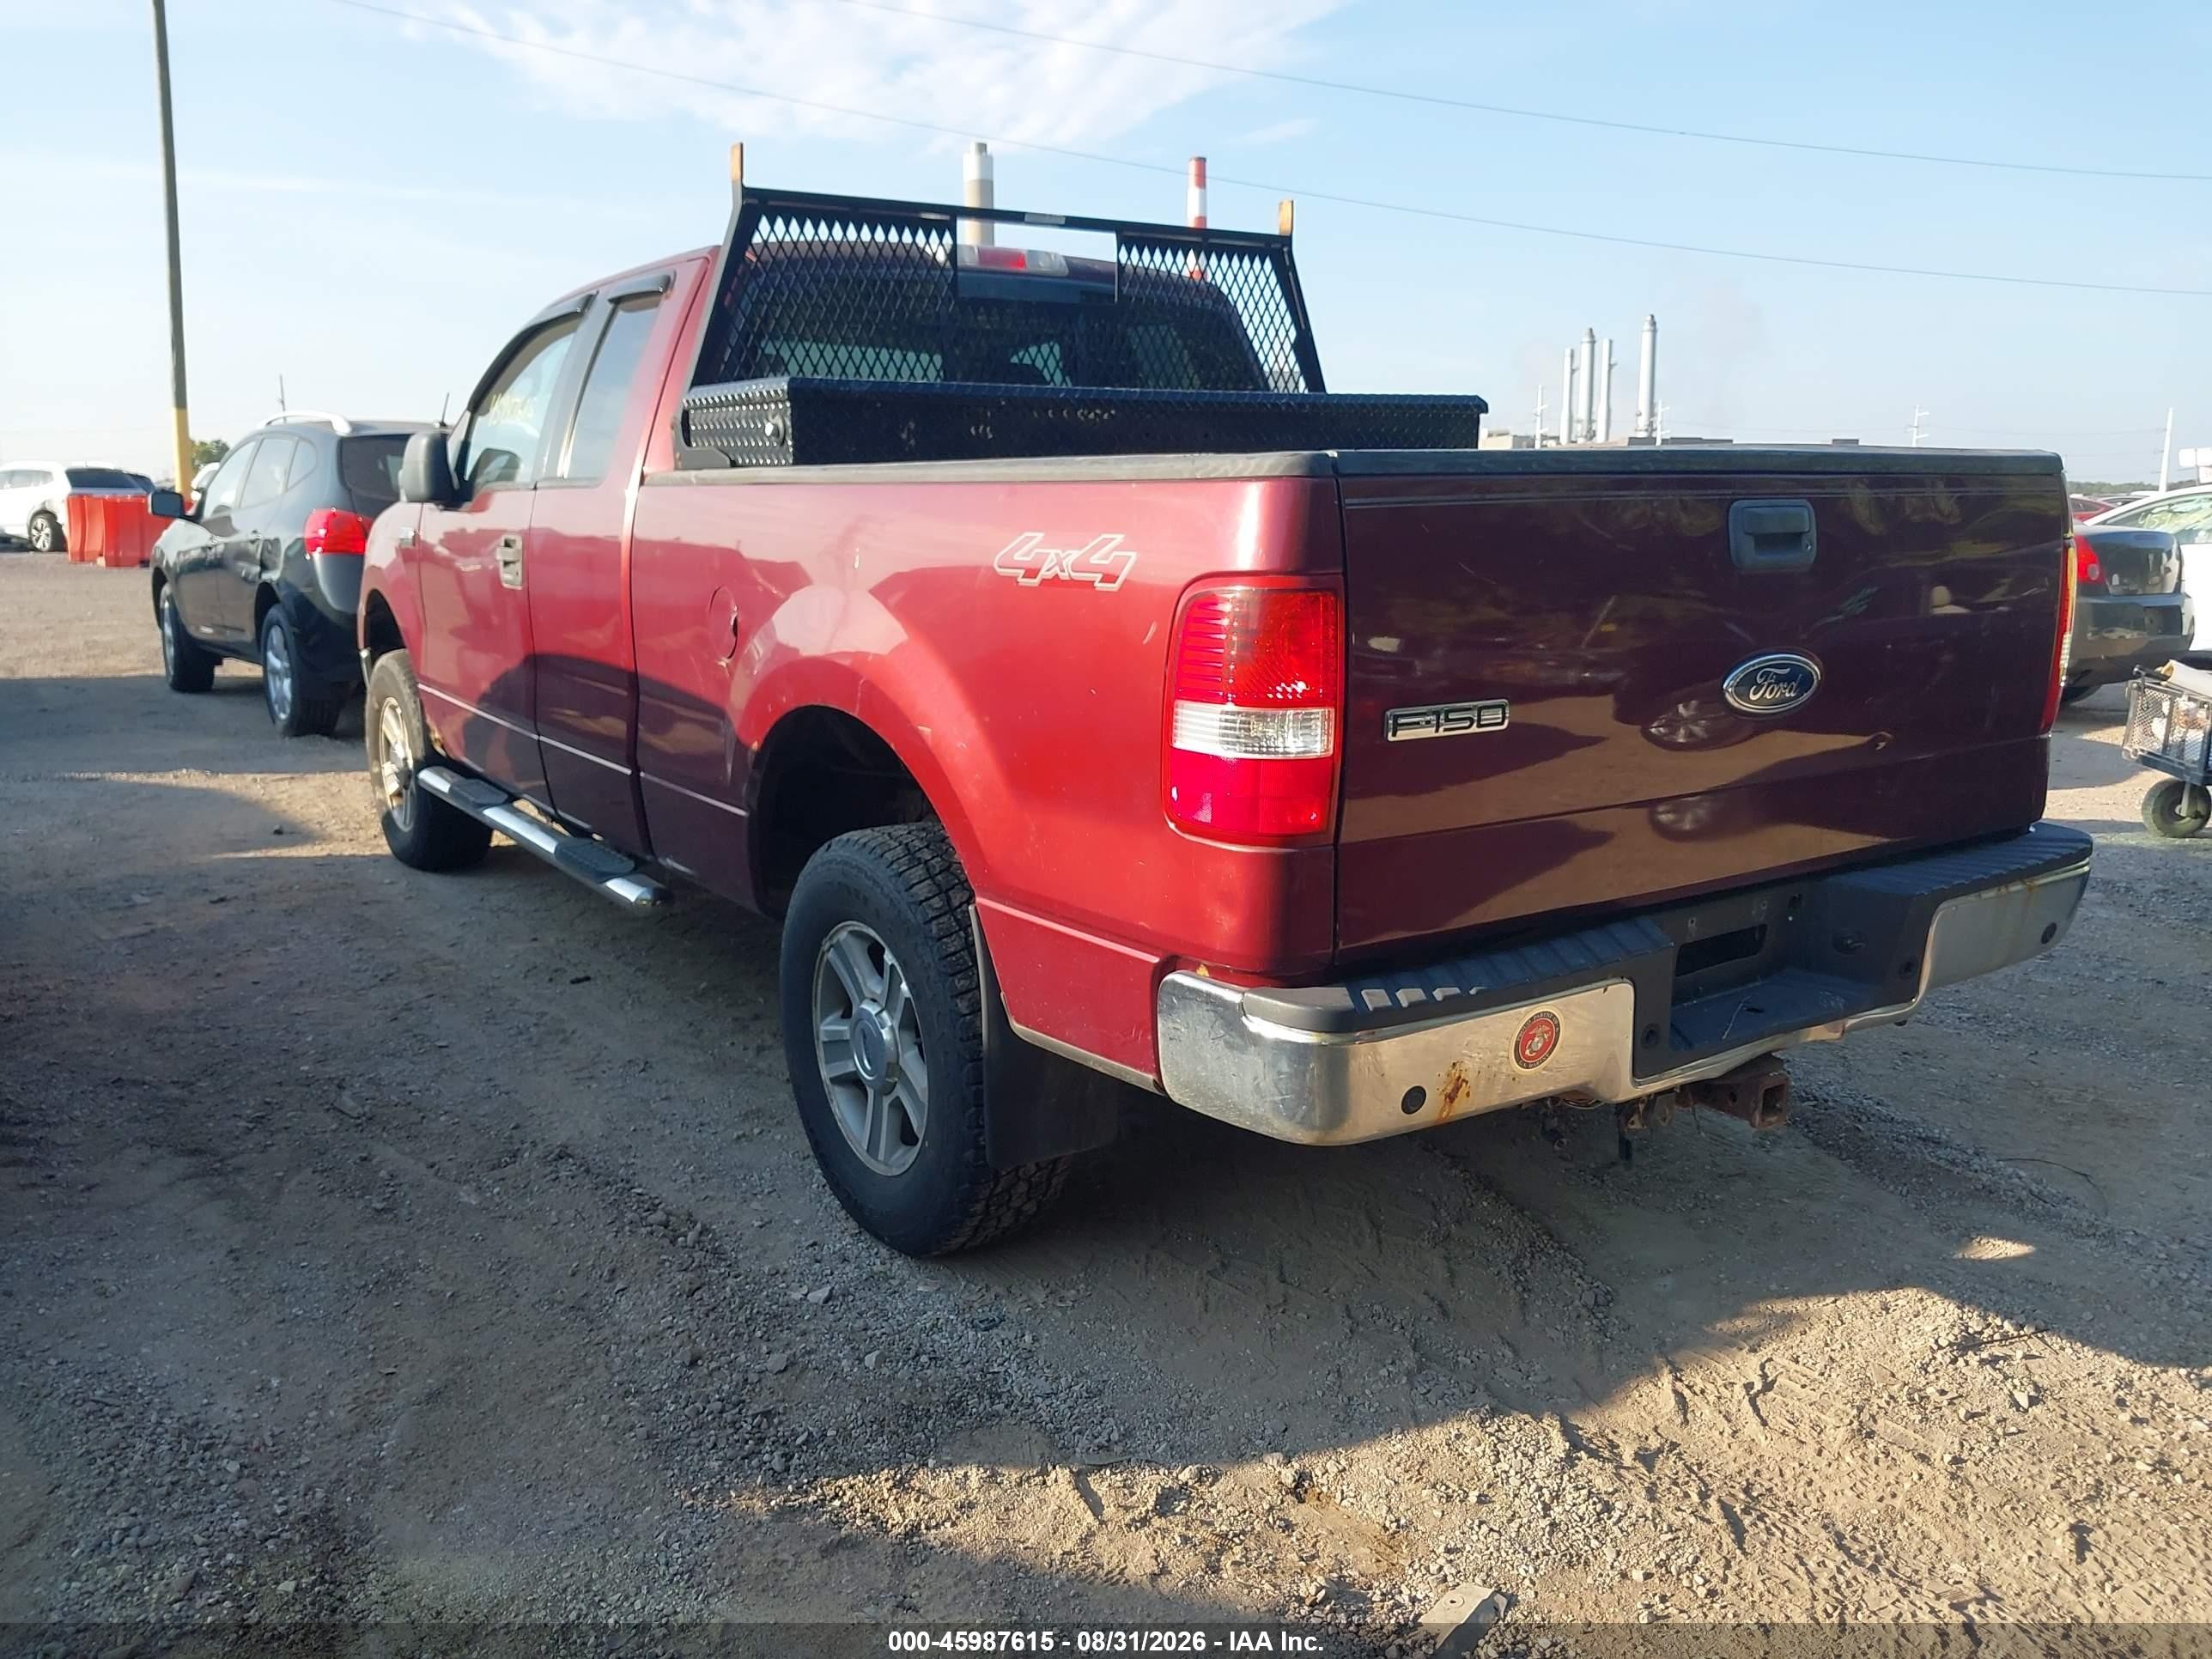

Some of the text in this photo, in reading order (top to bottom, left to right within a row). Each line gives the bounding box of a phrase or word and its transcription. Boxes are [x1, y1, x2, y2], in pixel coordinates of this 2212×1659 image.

[994, 532, 1138, 592] 4x4
[1749, 667, 1802, 701] Ford
[1391, 703, 1507, 738] F-150
